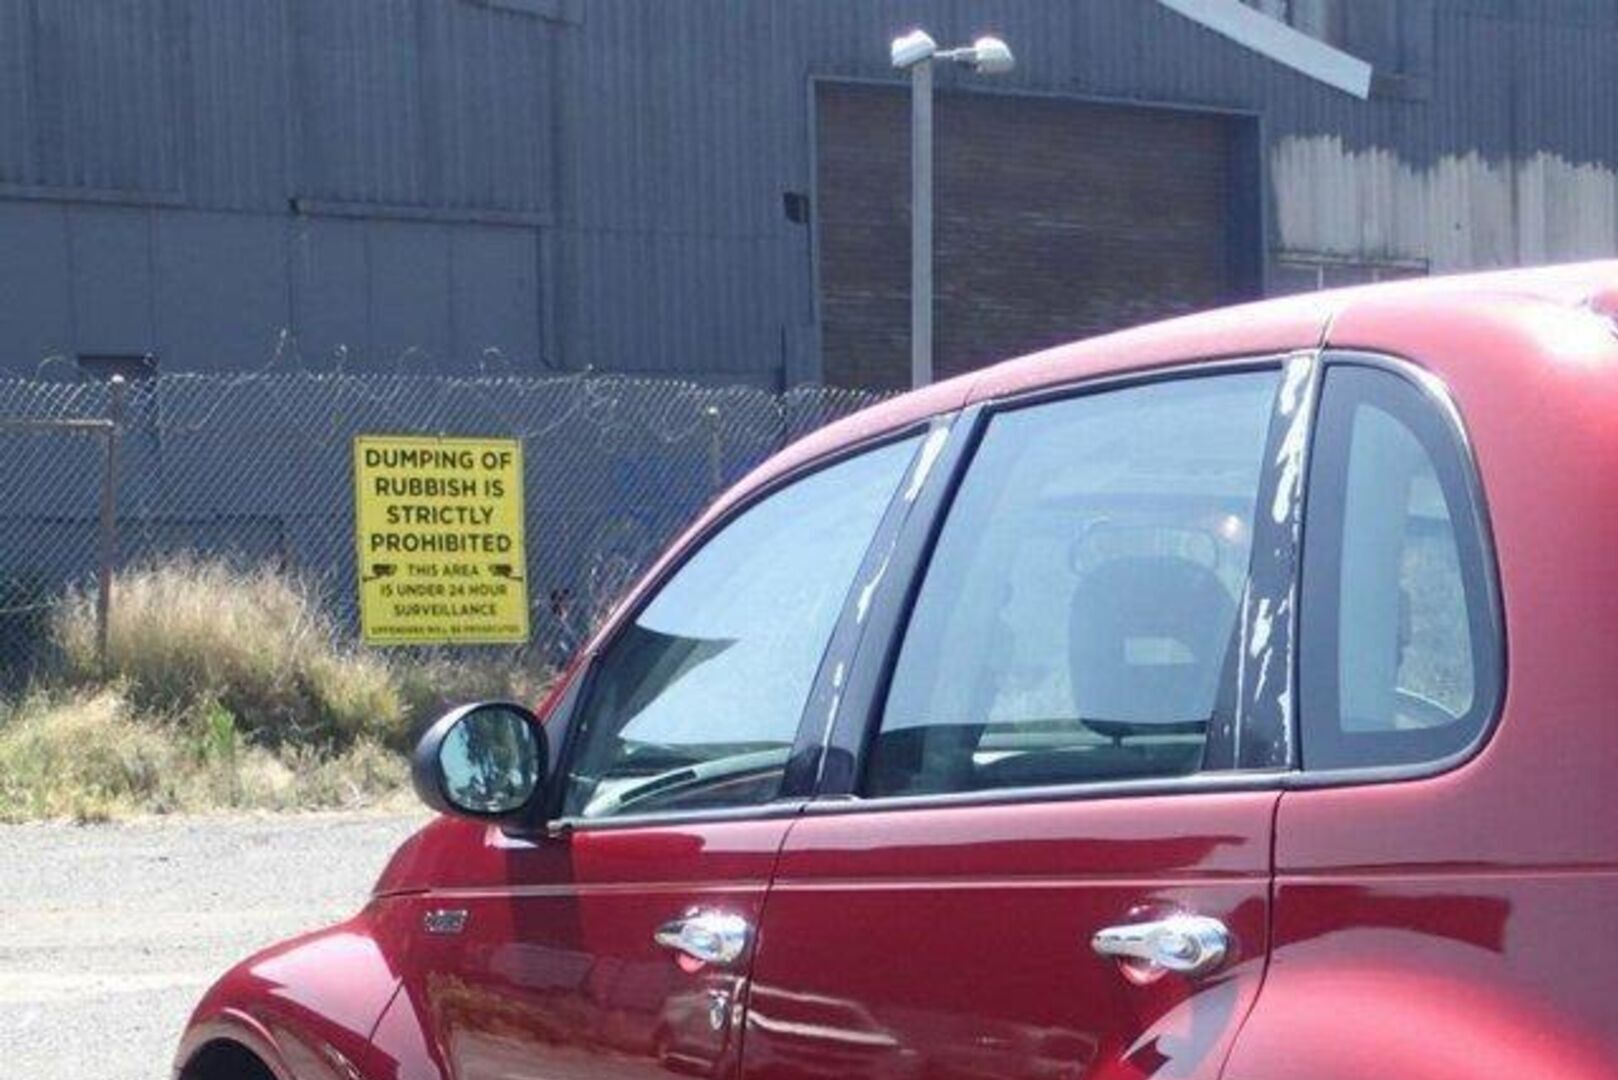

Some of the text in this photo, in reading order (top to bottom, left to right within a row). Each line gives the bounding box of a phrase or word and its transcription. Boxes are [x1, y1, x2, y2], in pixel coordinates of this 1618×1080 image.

[365, 449, 512, 470] DUMPING OF
[375, 477, 504, 497] RUBBISH IS
[386, 505, 494, 524] STRICTLY
[370, 533, 512, 552] PROHIBITED
[408, 563, 479, 576] THIS AREA
[380, 584, 393, 597] IS
[397, 584, 445, 597] UNDER
[468, 584, 507, 596] HOUR
[394, 603, 496, 617] SURVEILLANCE
